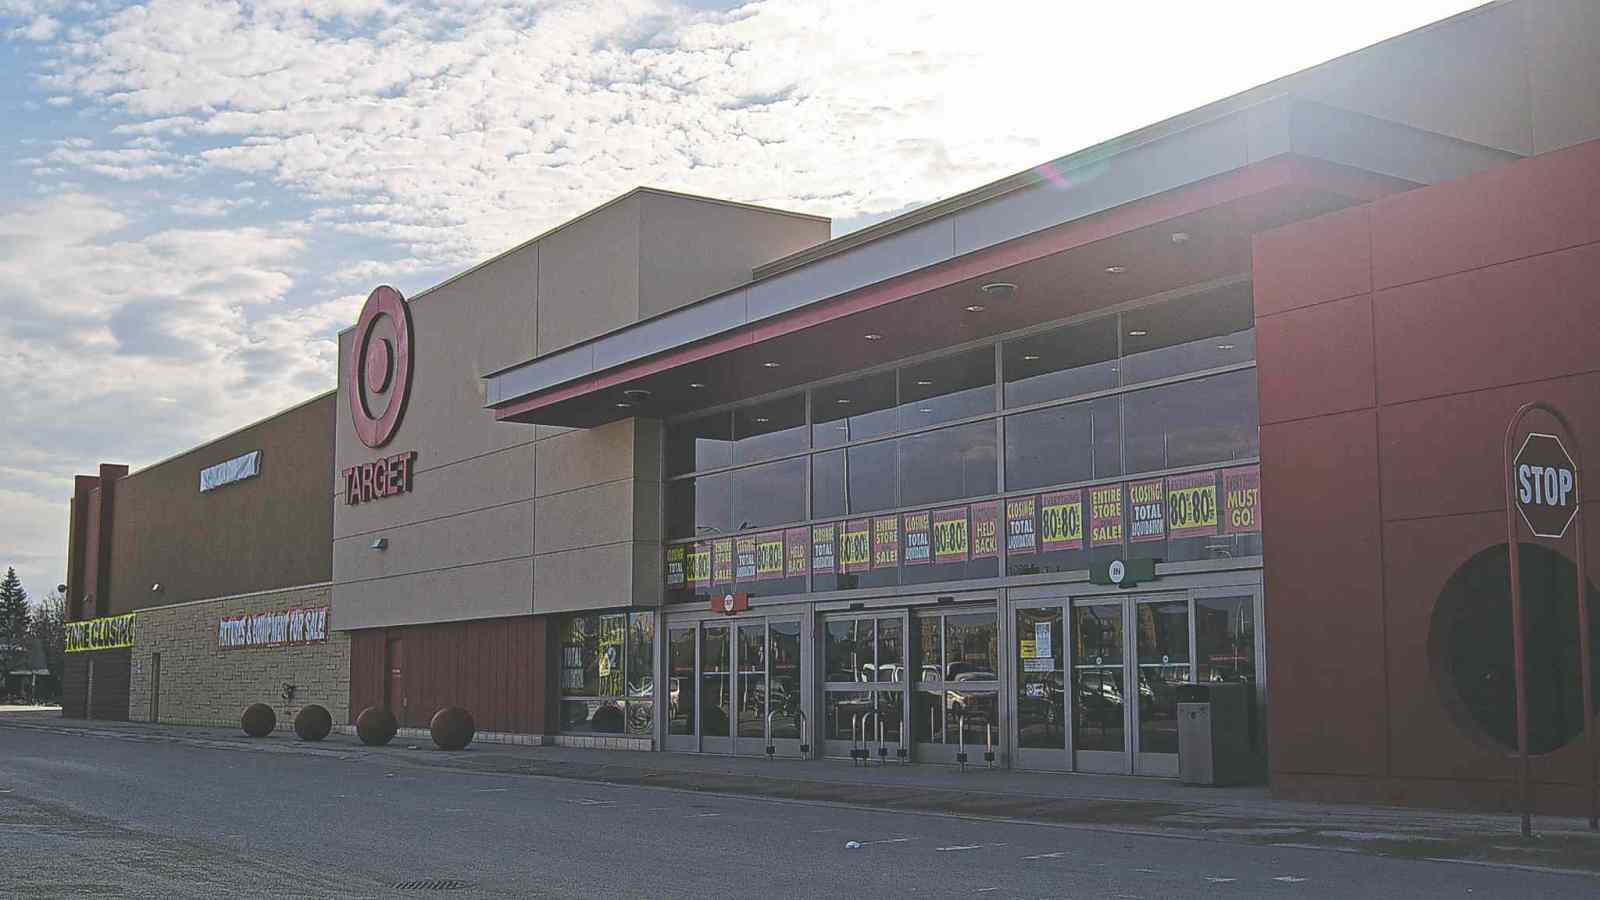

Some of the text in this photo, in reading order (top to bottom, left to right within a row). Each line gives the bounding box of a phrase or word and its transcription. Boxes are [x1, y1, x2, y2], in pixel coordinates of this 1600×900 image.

[342, 451, 416, 505] TARGET
[1519, 463, 1573, 506] STOP
[1092, 488, 1120, 504] ENTIRE
[1130, 483, 1163, 503] CLOSING!
[1227, 488, 1258, 508] MUST
[1093, 503, 1120, 518] STORE
[1134, 503, 1162, 520] TOTAL
[1232, 507, 1255, 528] GO!
[976, 521, 995, 537] HELD
[1010, 520, 1033, 534] TOTAL
[1093, 525, 1121, 541] SALE!
[876, 531, 897, 544] STORE
[909, 533, 928, 546] TOTAL
[815, 543, 832, 556] TOTAL
[289, 612, 305, 641] FOR
[564, 647, 583, 668] TOTAL
